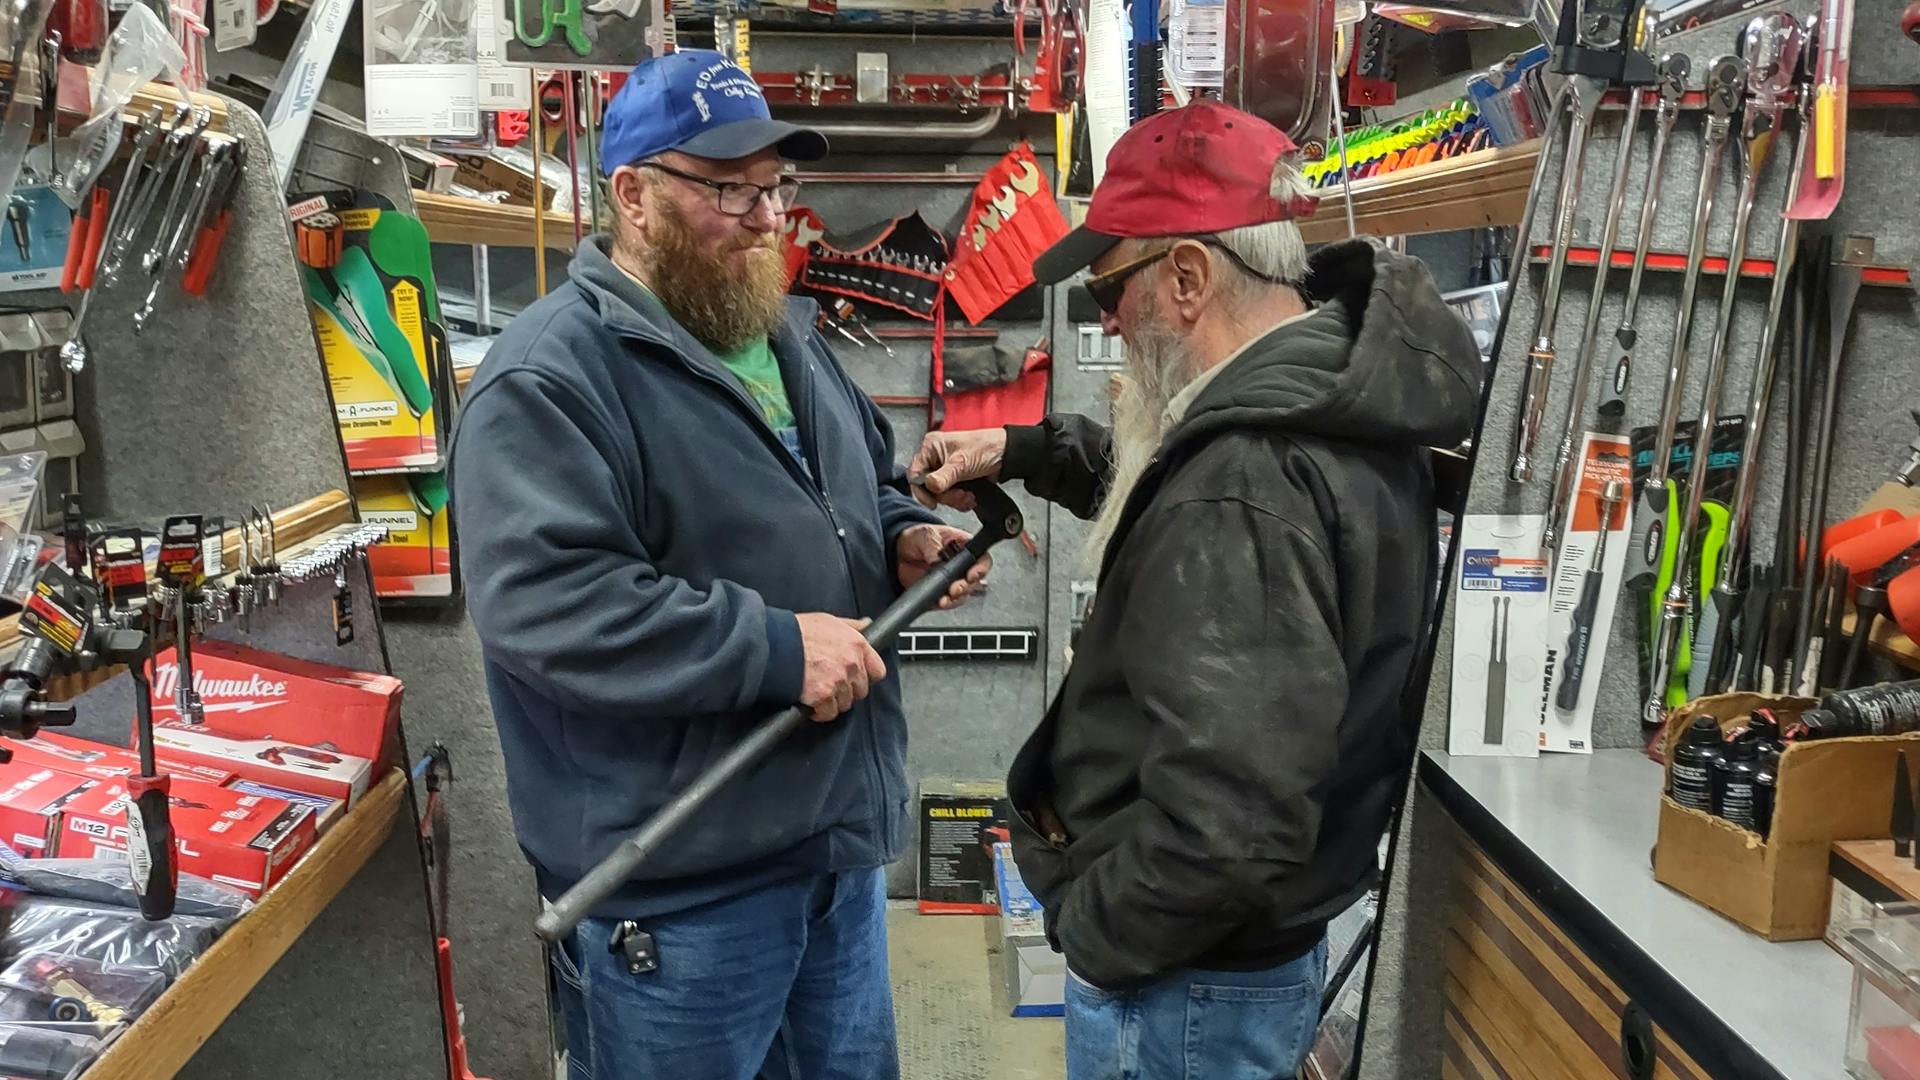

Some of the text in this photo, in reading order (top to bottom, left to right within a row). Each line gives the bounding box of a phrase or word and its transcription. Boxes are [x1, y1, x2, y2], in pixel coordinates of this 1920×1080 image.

[289, 198, 325, 218] RIGINAL
[154, 662, 287, 699] Mlwaukee
[929, 807, 993, 817] CHILL BLOWER
[73, 820, 106, 835] M12
